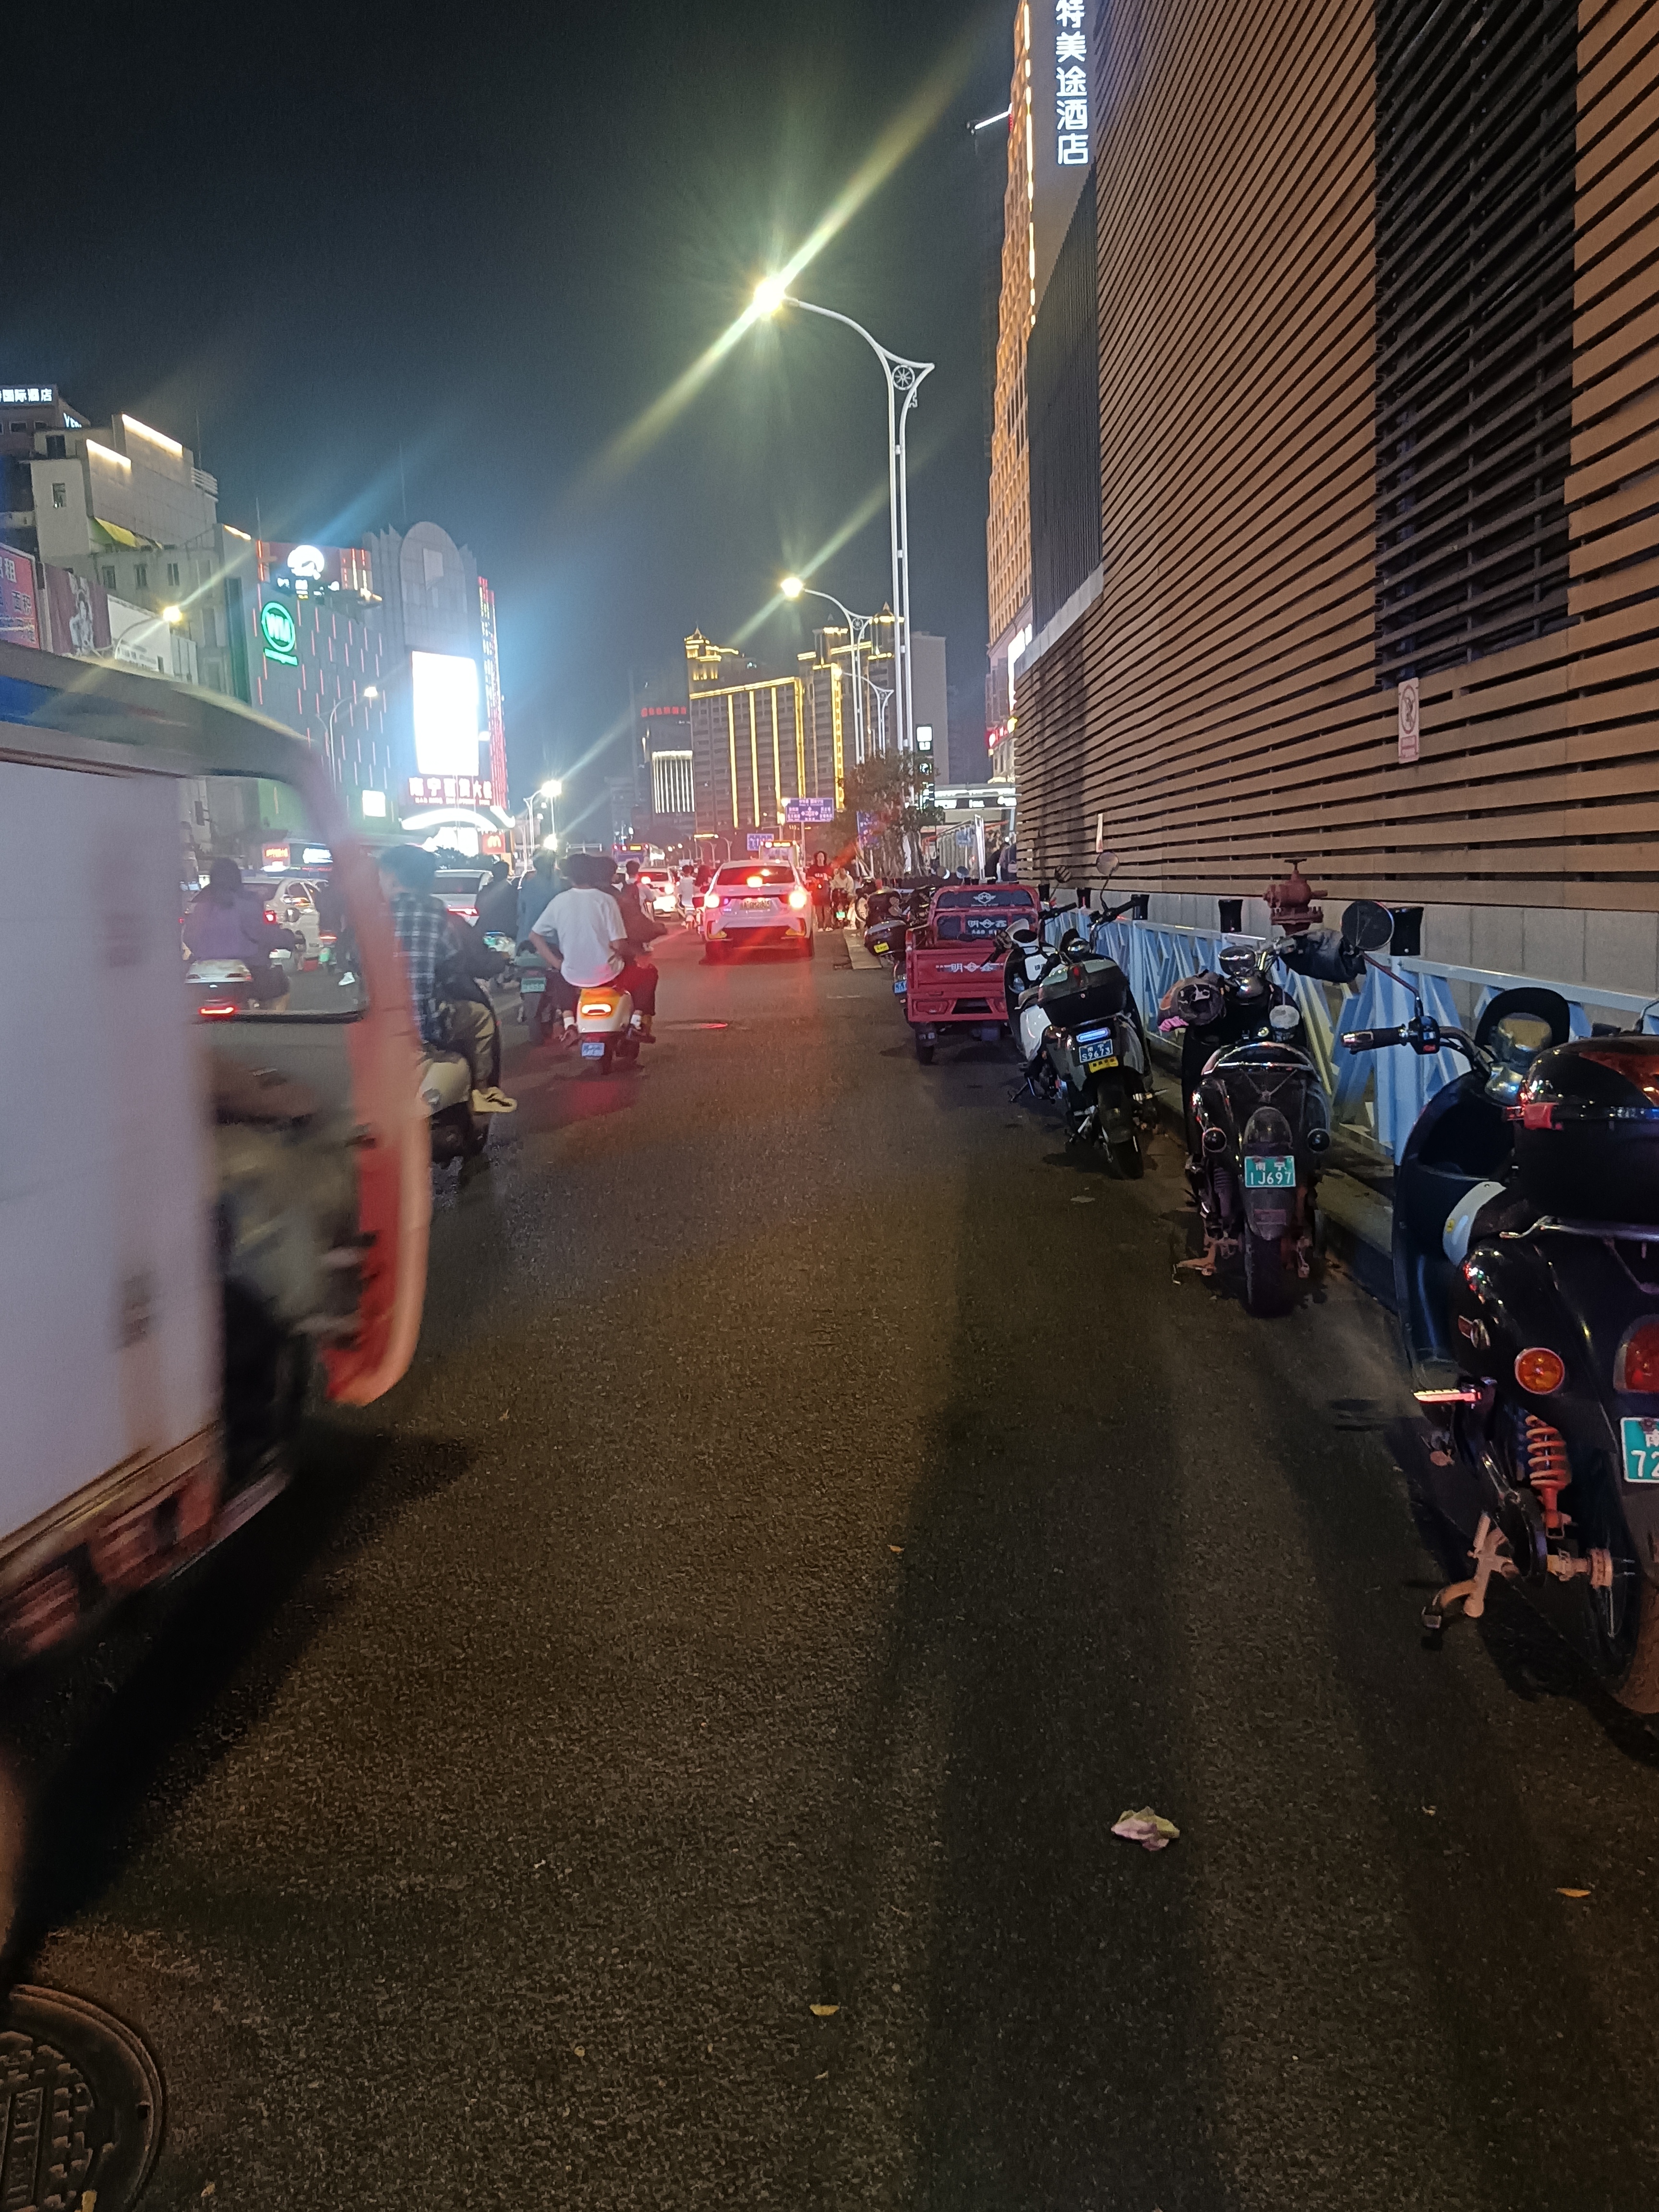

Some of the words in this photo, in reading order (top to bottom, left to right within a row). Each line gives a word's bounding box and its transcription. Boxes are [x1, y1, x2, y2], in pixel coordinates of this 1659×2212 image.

[1055, 0, 1089, 165] 特美途酒店
[0, 388, 52, 403] 国际酒店
[1082, 1047, 1110, 1061] S9673
